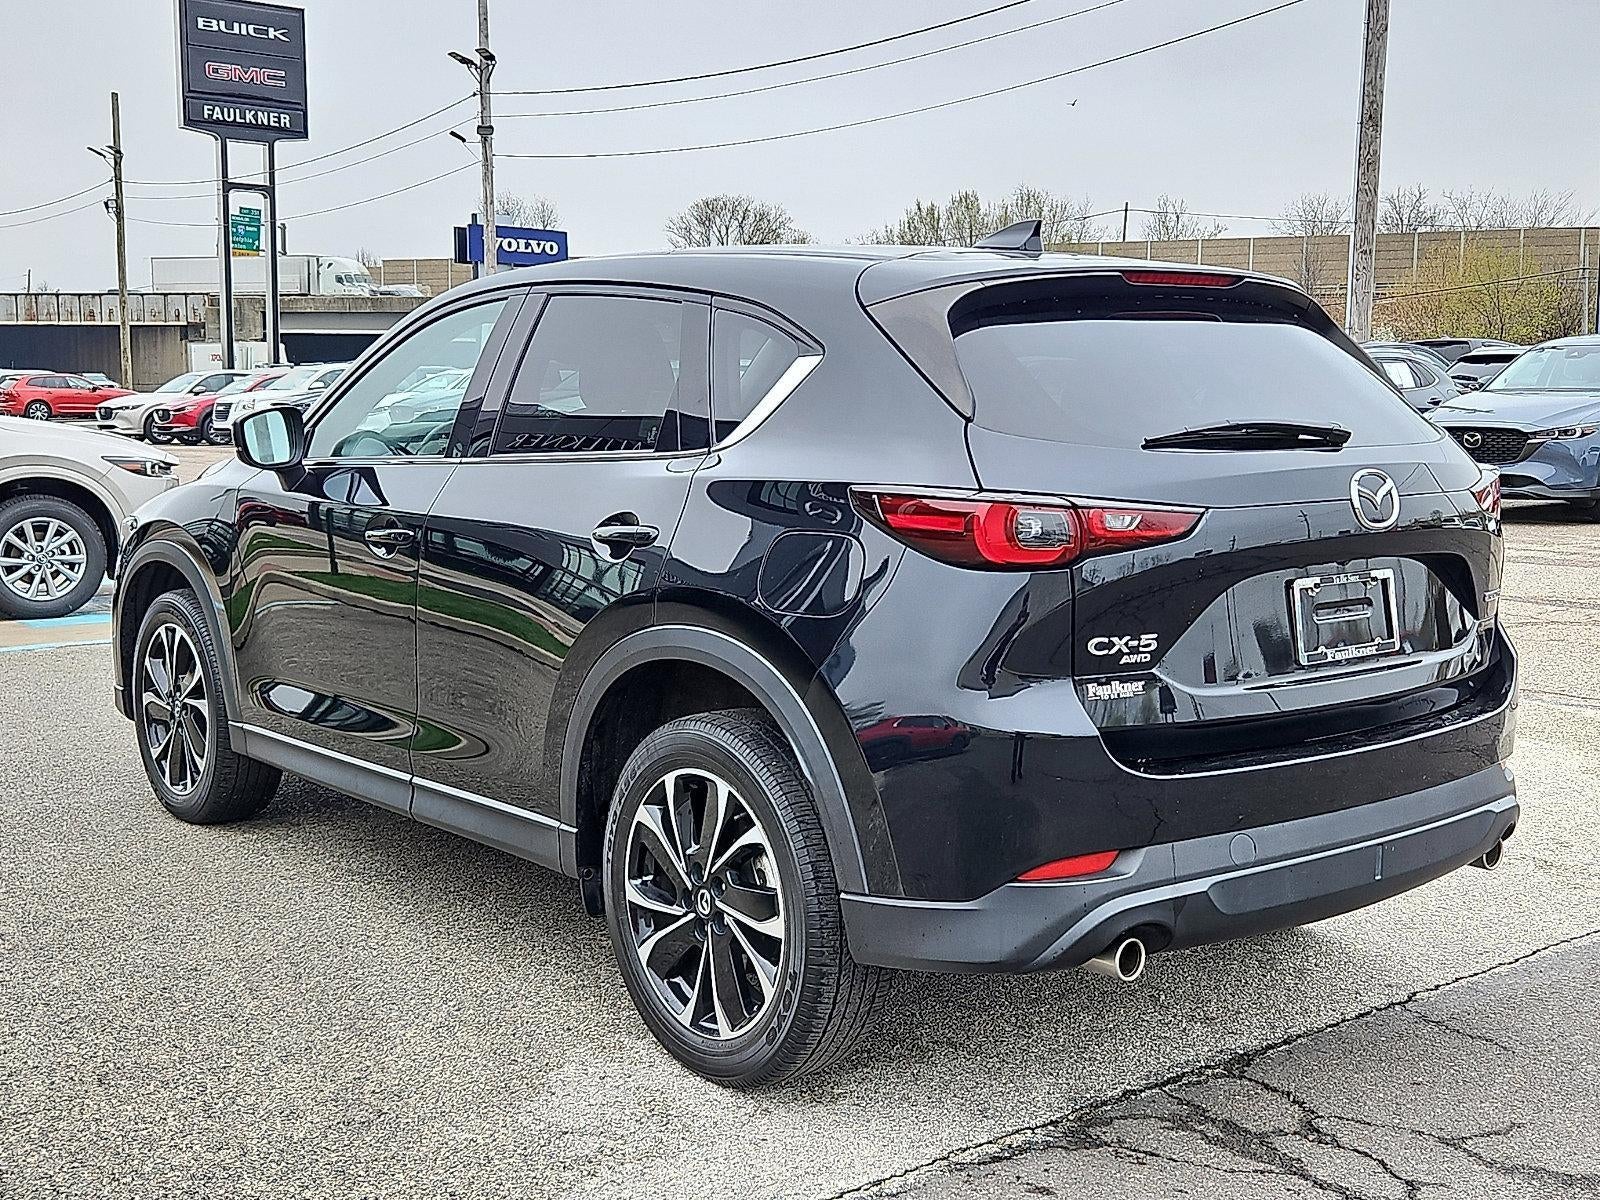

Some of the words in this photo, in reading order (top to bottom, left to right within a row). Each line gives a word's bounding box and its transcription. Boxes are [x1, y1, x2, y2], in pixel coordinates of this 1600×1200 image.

[197, 17, 290, 42] BUICK
[205, 61, 286, 87] GMC
[203, 105, 290, 128] FAULKNER
[1087, 633, 1158, 655] CX-5
[1327, 645, 1378, 661] Faulkner
[1119, 653, 1151, 664] AWD
[1087, 680, 1146, 698] Faulkner
